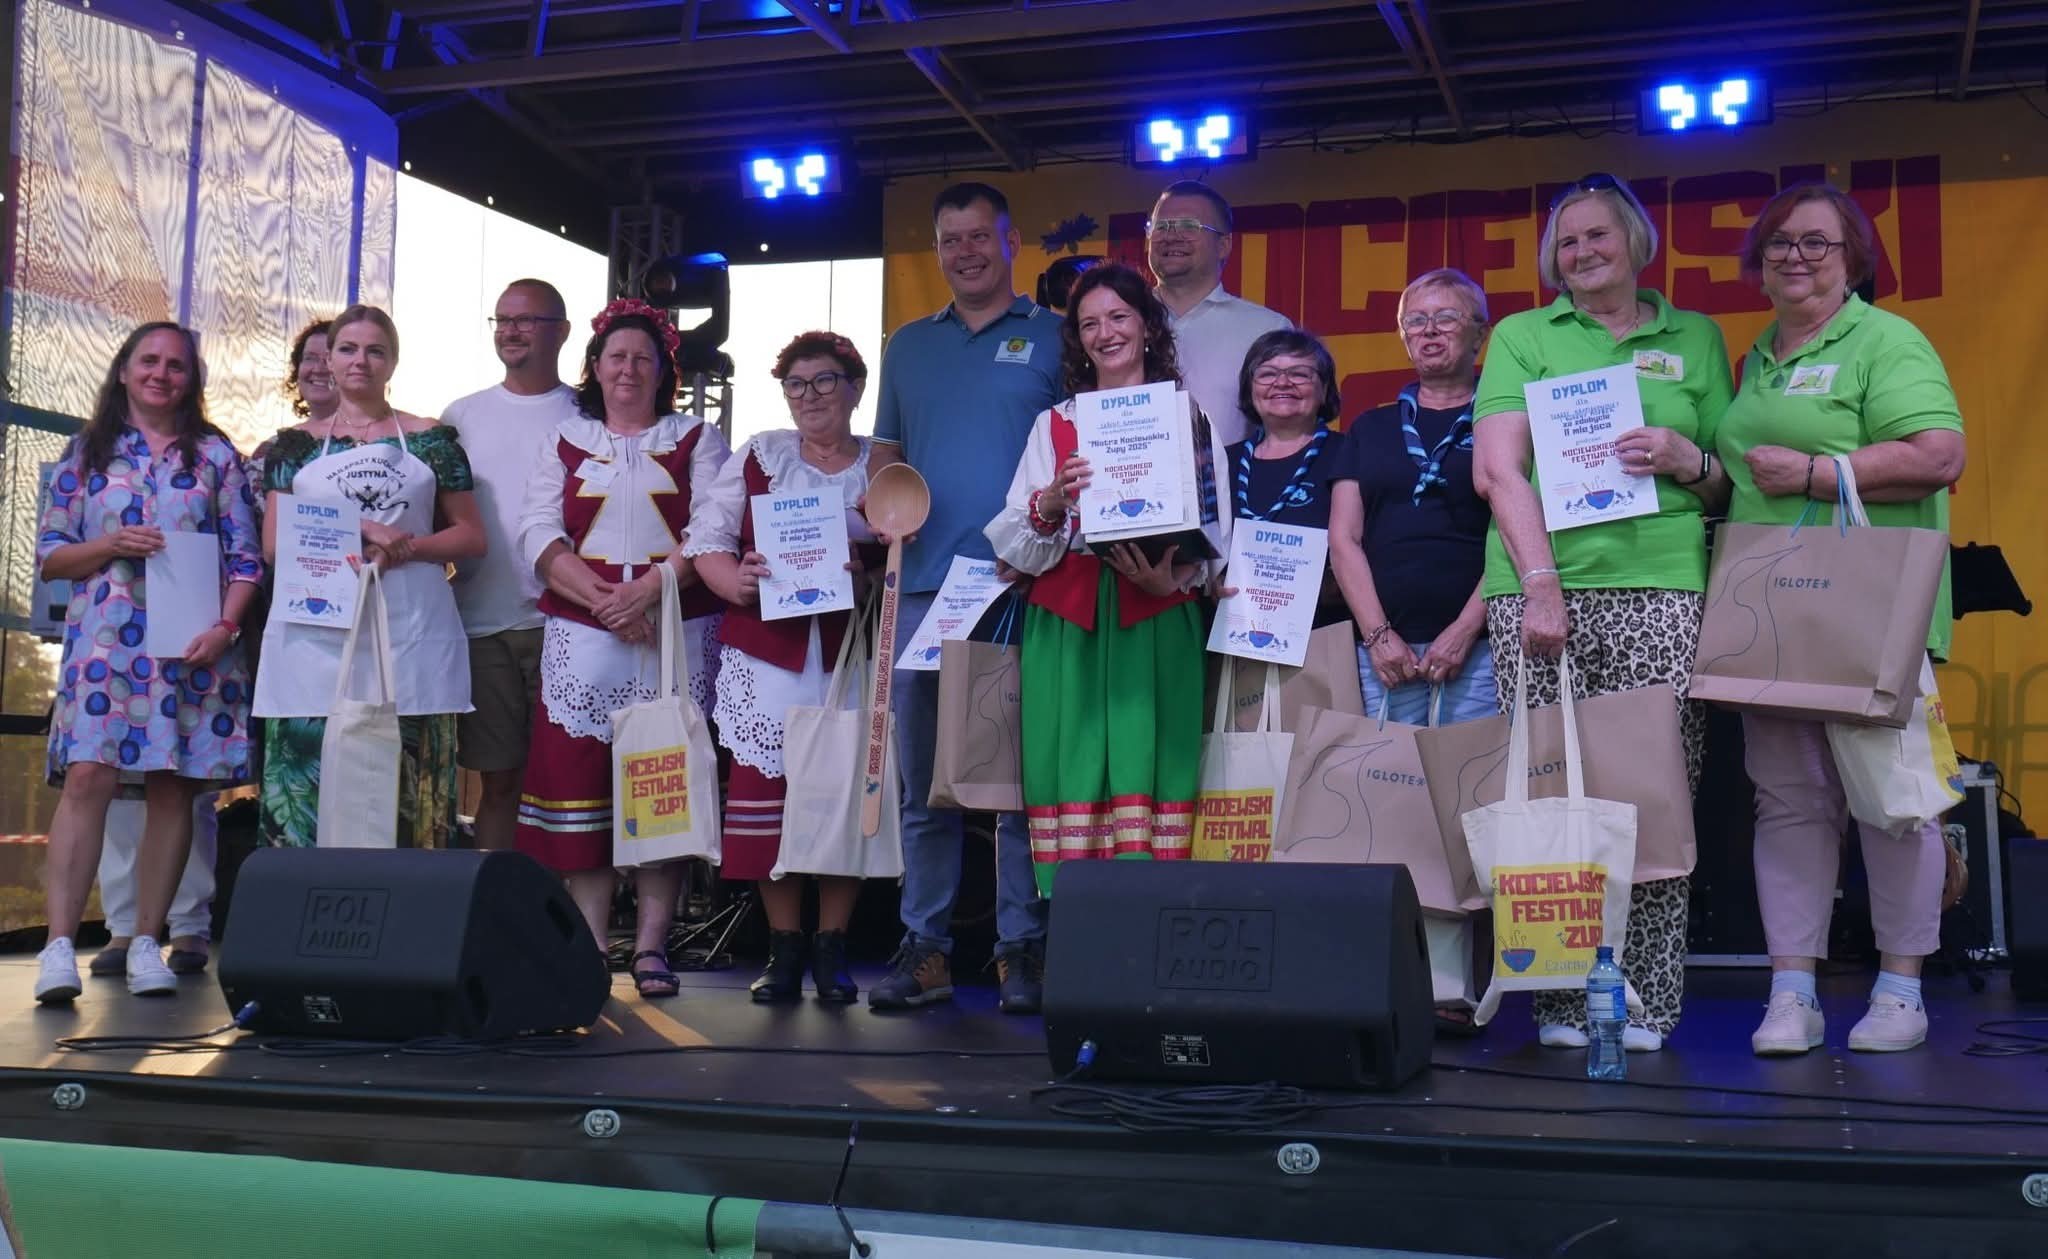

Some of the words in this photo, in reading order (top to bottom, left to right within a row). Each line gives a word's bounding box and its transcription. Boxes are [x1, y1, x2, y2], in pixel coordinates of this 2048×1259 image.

[1551, 378, 1608, 400] DYPLOM
[1101, 392, 1151, 410] DYPLOM
[1572, 422, 1612, 435] miejsca
[1120, 432, 1170, 445] Kociewskiej
[1571, 451, 1616, 464] FESTIWALU
[1584, 459, 1605, 469] ZUPY
[346, 470, 388, 478] JUSTYNA
[1104, 462, 1153, 473] KOCIEWSKIEGO
[1111, 470, 1149, 479] FESTIWALU
[1121, 477, 1139, 485] ZUPY
[297, 504, 339, 519] DYPLOM
[774, 496, 820, 512] DYPLOM
[1255, 530, 1303, 547] DYPLOM
[779, 548, 827, 560] KOCIEWSKIEGO
[1775, 577, 1829, 589] IGLOTEX
[1245, 587, 1295, 600] KOCIEWSKIEGO
[1250, 595, 1289, 607] FESTIWALU
[872, 711, 885, 742] ZUPY
[632, 773, 687, 799] ESTIWAL
[654, 794, 688, 817] ZUPY
[1203, 820, 1271, 840] FESTIWAL
[1231, 844, 1271, 862] ZUPY
[312, 895, 376, 924] POL
[1512, 898, 1603, 923] FESTIWA
[305, 929, 370, 951] AUDIO
[1170, 917, 1262, 951] POL
[1565, 925, 1603, 949] ZUP
[1169, 959, 1259, 981] AUDIO
